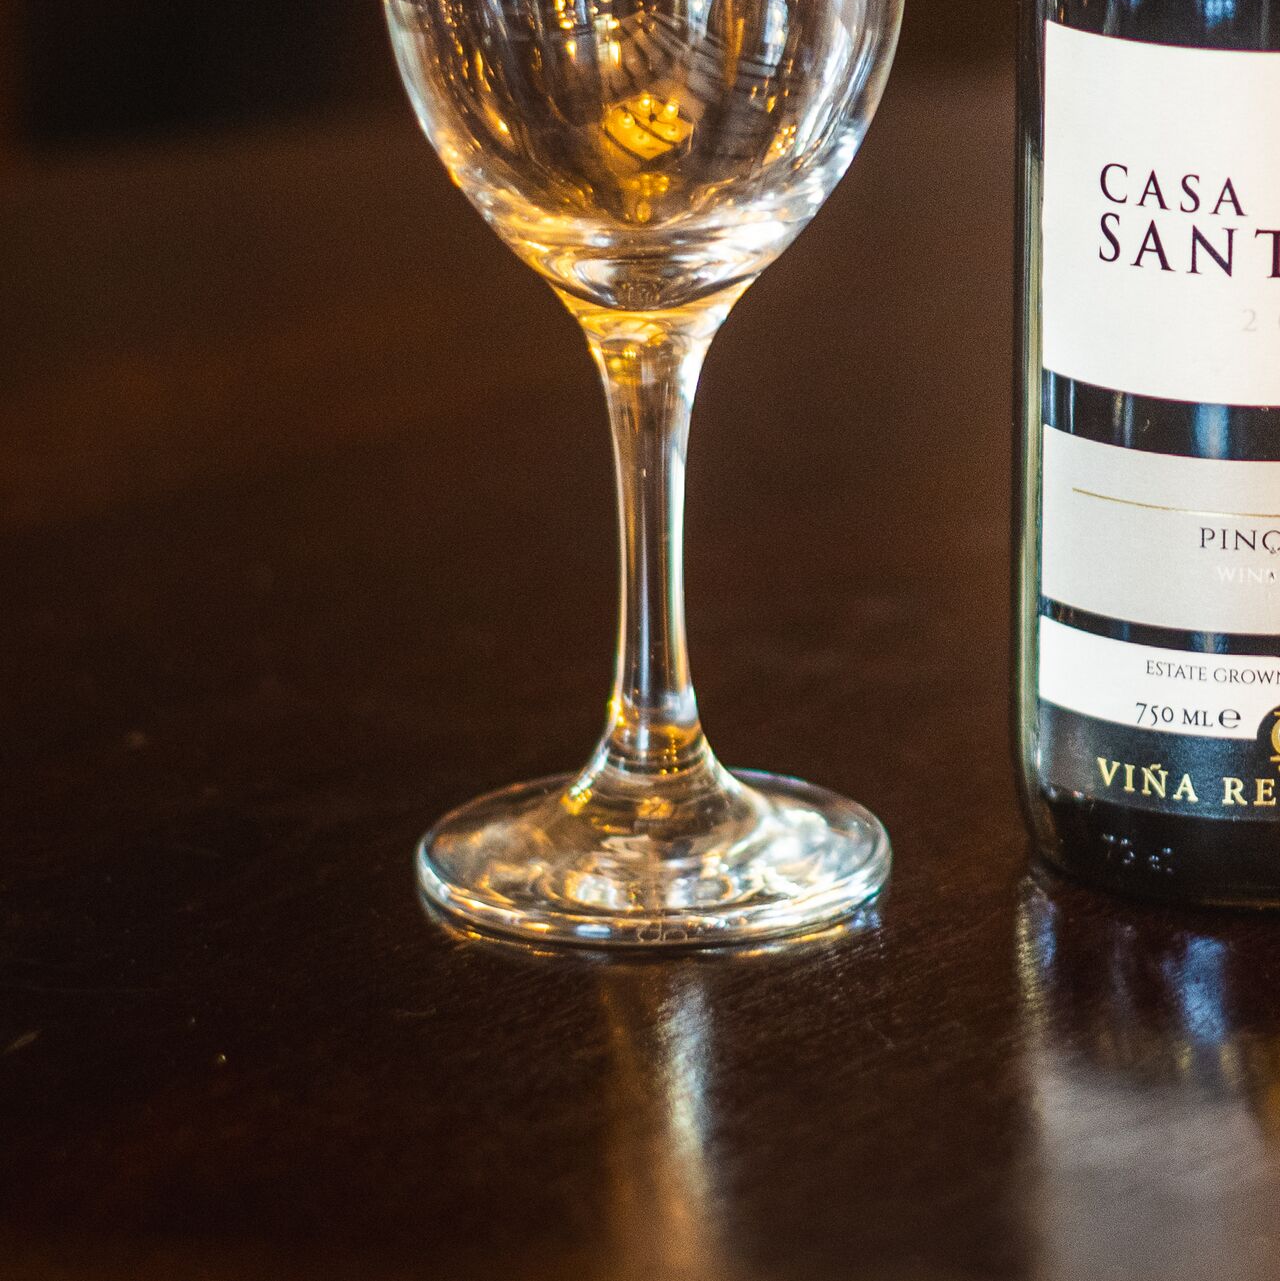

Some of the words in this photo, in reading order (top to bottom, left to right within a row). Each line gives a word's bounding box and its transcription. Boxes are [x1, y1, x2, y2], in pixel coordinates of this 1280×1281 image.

[1099, 163, 1248, 217] CASA
[1145, 659, 1208, 682] ESTATE
[1135, 702, 1175, 729] 750
[1096, 756, 1199, 803] VIÑA
